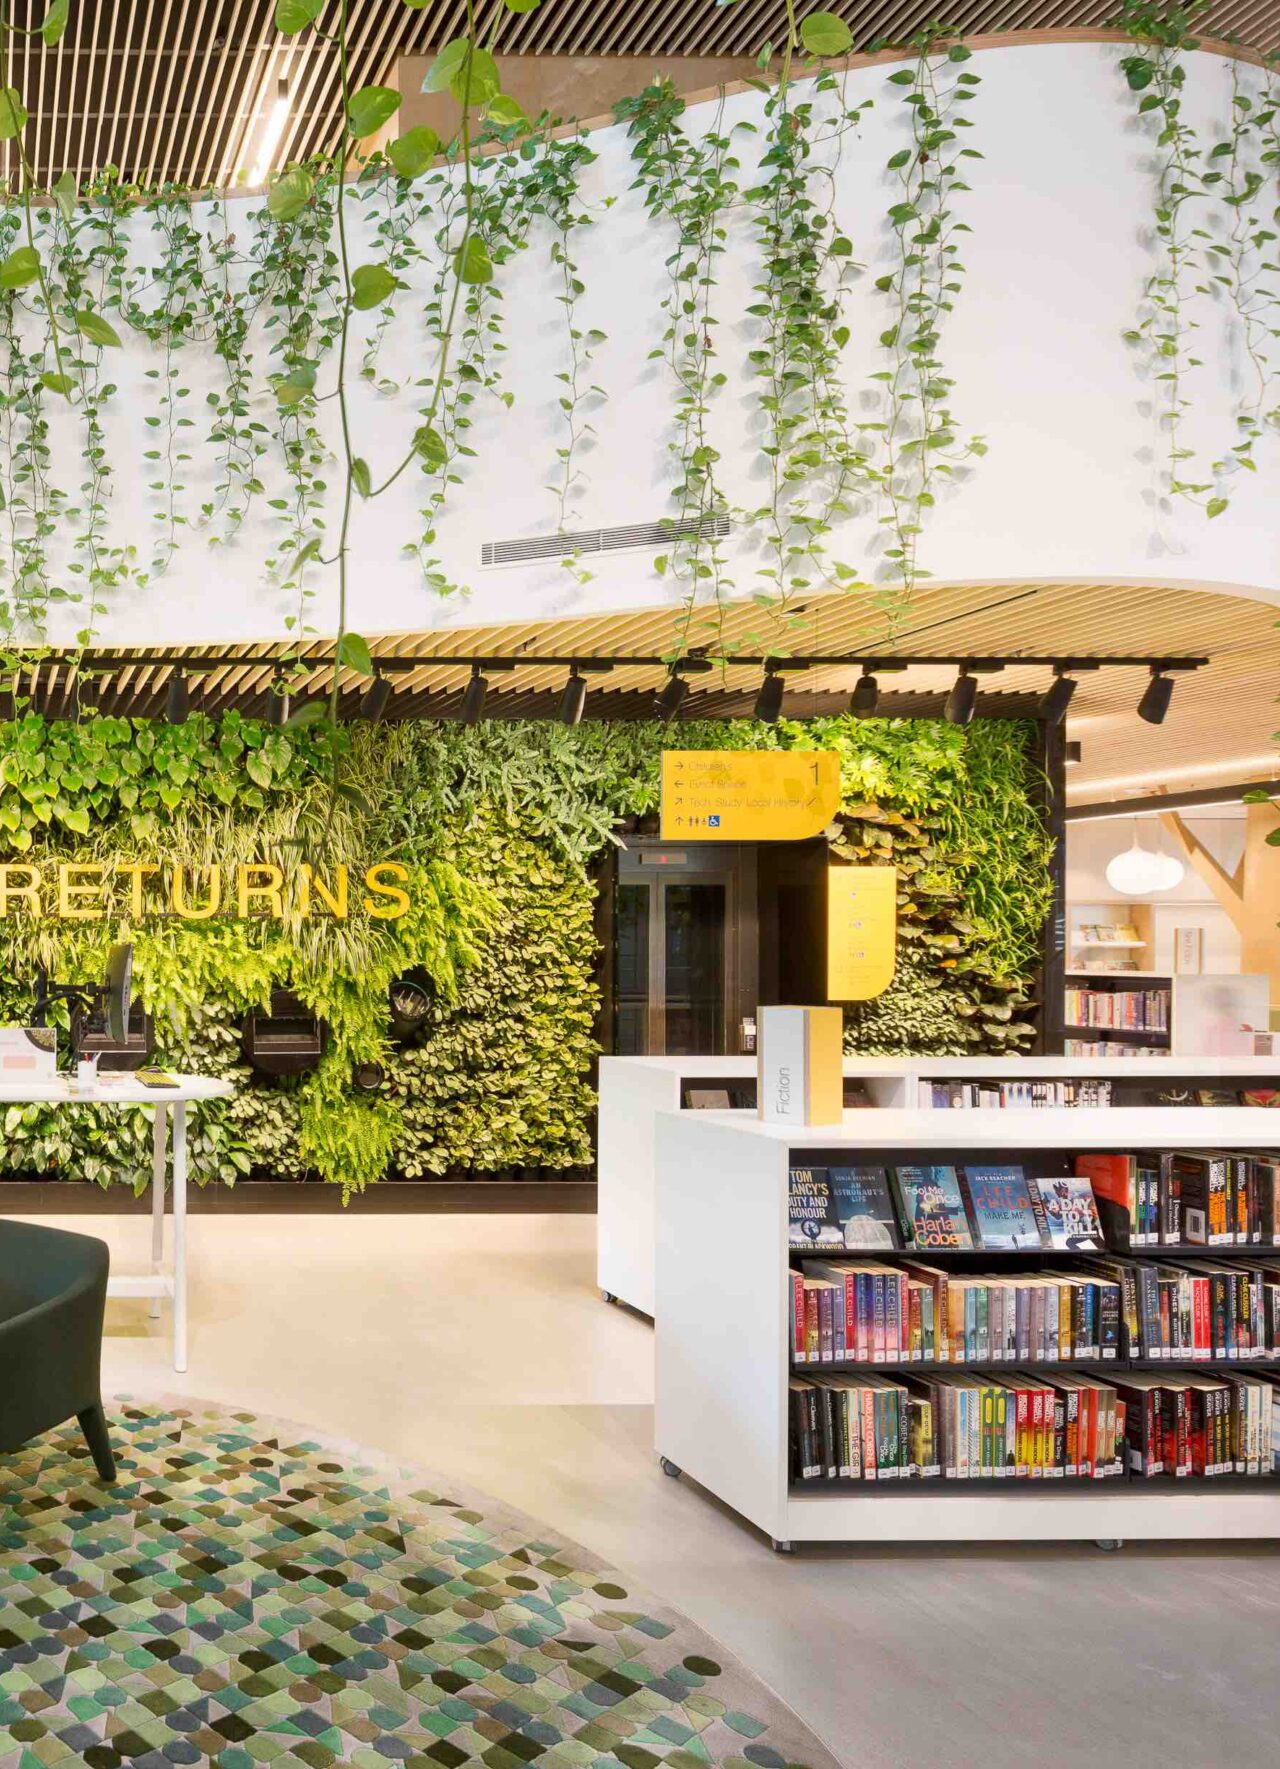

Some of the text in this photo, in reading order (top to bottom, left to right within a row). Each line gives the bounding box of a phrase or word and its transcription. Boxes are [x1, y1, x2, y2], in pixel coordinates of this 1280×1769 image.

[810, 761, 819, 786] 1
[776, 1066, 791, 1115] Fiction
[789, 1170, 813, 1183] TOM
[833, 1188, 885, 1196] ASTRONAUT'S
[904, 1184, 944, 1195] Fool Me
[983, 1184, 1013, 1197] LEE
[810, 1196, 828, 1207] AND
[924, 1192, 959, 1204] Once
[976, 1196, 1029, 1210] CHILD
[1048, 1198, 1091, 1211] A DAY
[790, 1207, 827, 1218] HONOUR
[984, 1211, 1026, 1220] MAKE ME
[1059, 1210, 1080, 1223] TO
[913, 1216, 966, 1238] Harlan
[1063, 1221, 1097, 1236] KILL
[916, 1230, 971, 1246] Coben
[875, 1276, 883, 1294] LEE
[795, 1283, 804, 1328] LEE CHILD
[887, 1276, 896, 1327] LEE CHILD
[865, 1394, 874, 1429] HARLAN
